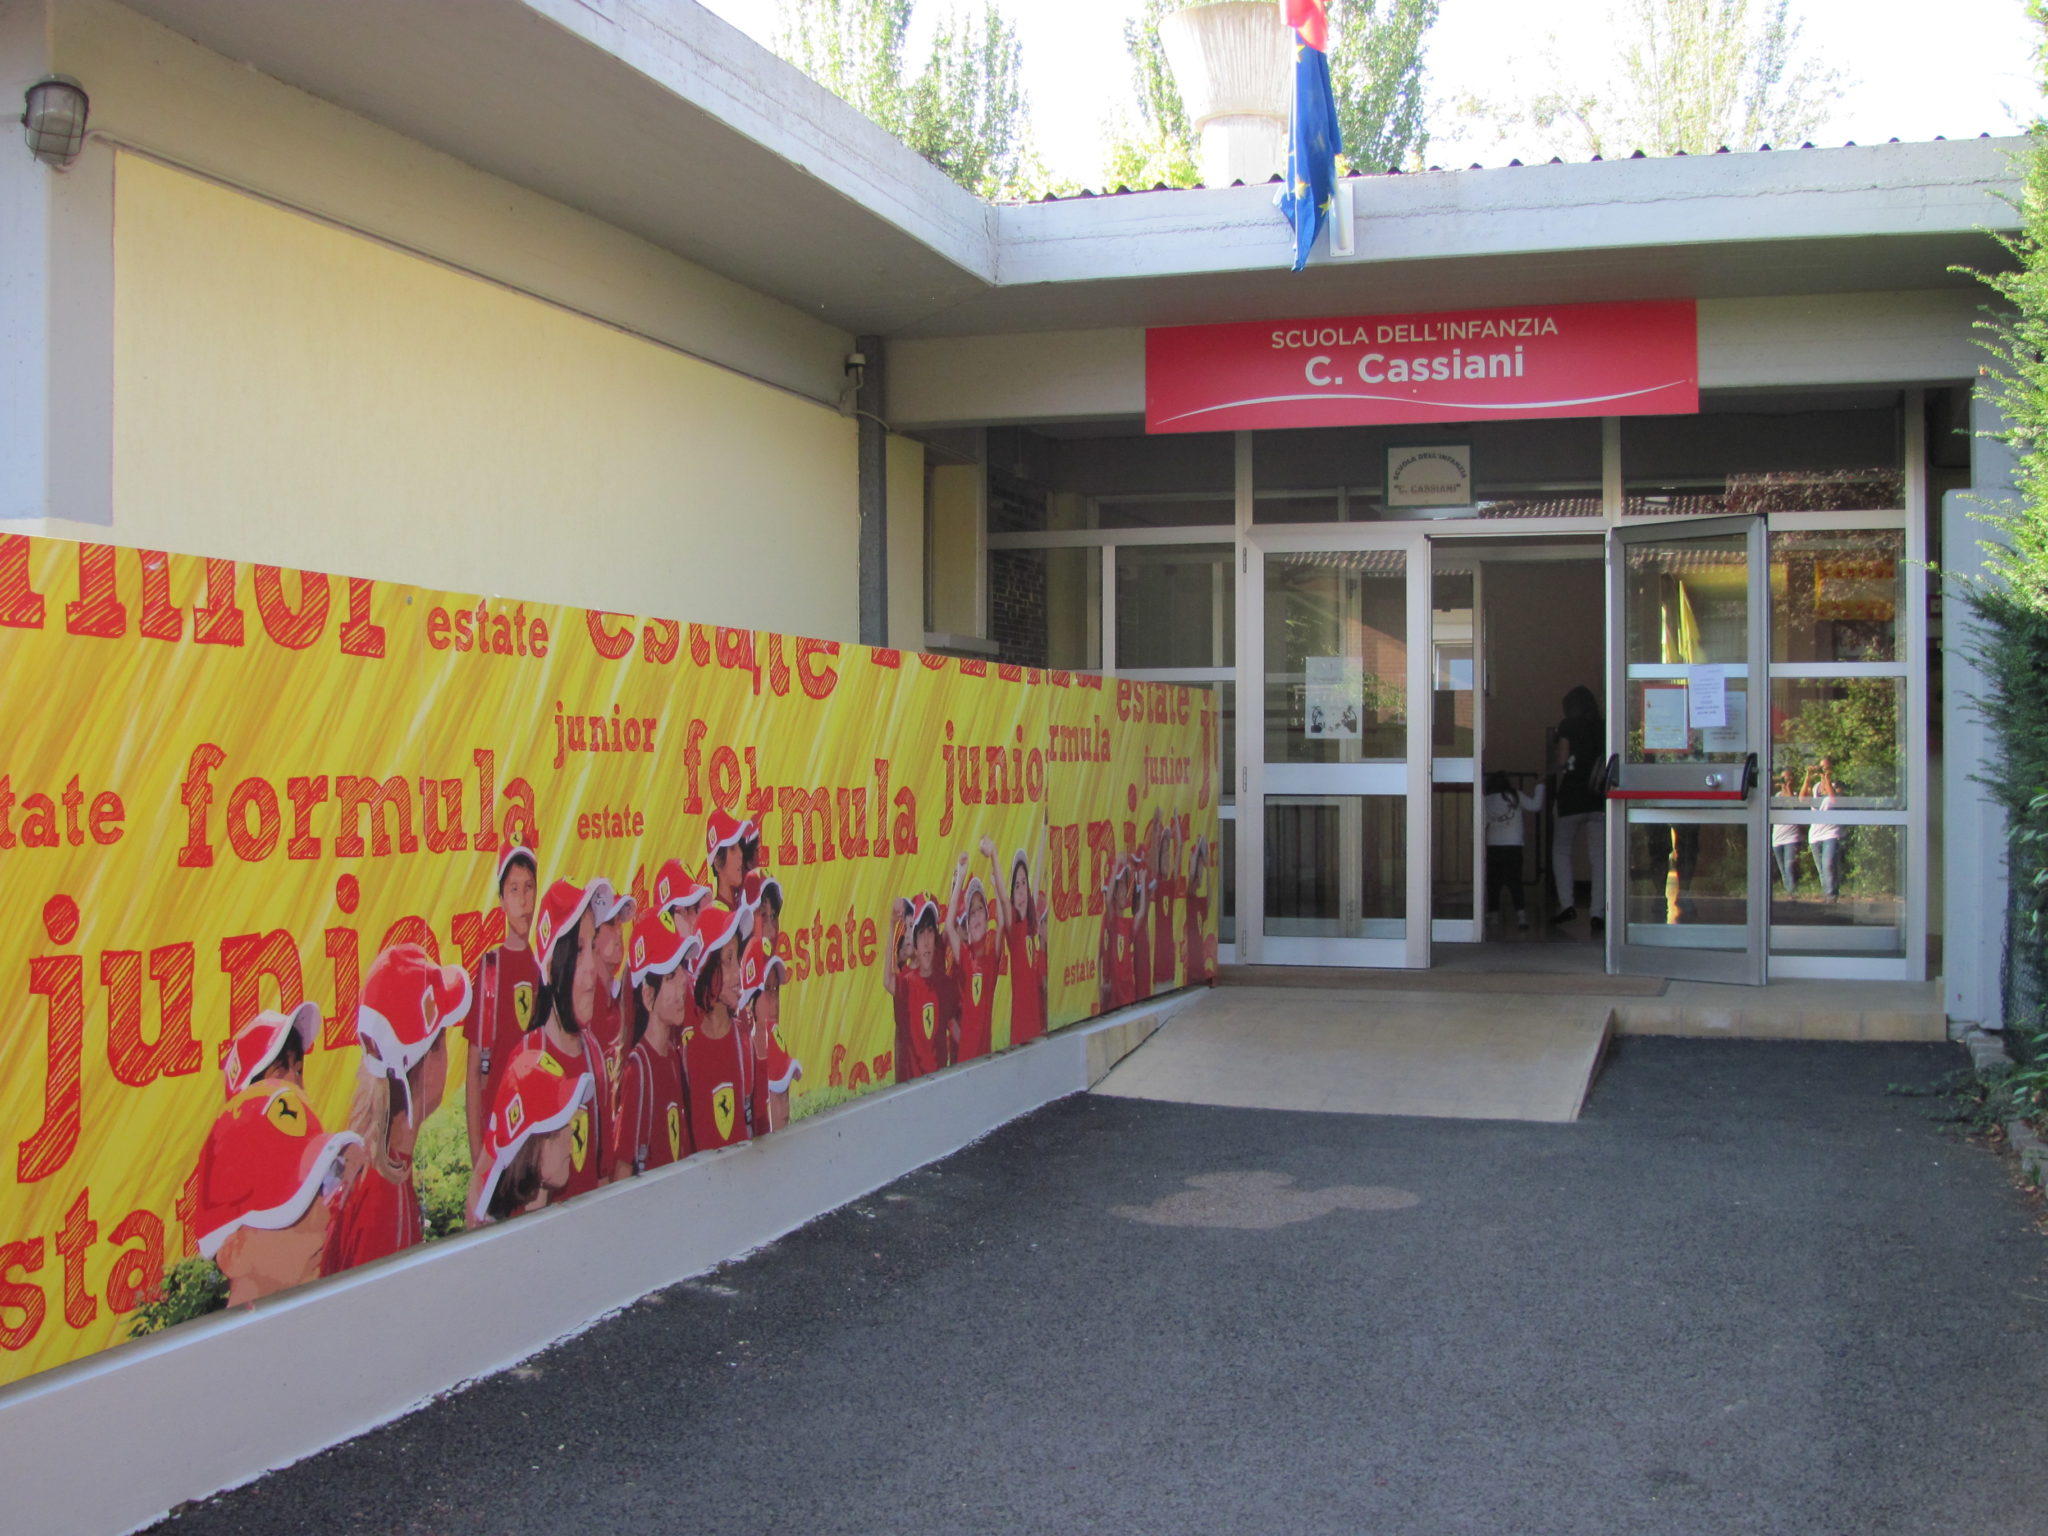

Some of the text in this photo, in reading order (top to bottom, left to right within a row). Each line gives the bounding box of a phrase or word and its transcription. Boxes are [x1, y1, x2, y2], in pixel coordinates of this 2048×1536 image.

[1271, 318, 1558, 348] SCUOLA DELL'INFANZIA
[1305, 346, 1523, 386] C. Cassiani
[427, 599, 549, 658] estate
[554, 700, 656, 769] junior
[1143, 745, 1191, 800] junior
[178, 742, 540, 868] formula
[577, 803, 645, 840] estate
[1063, 956, 1096, 987] estate
